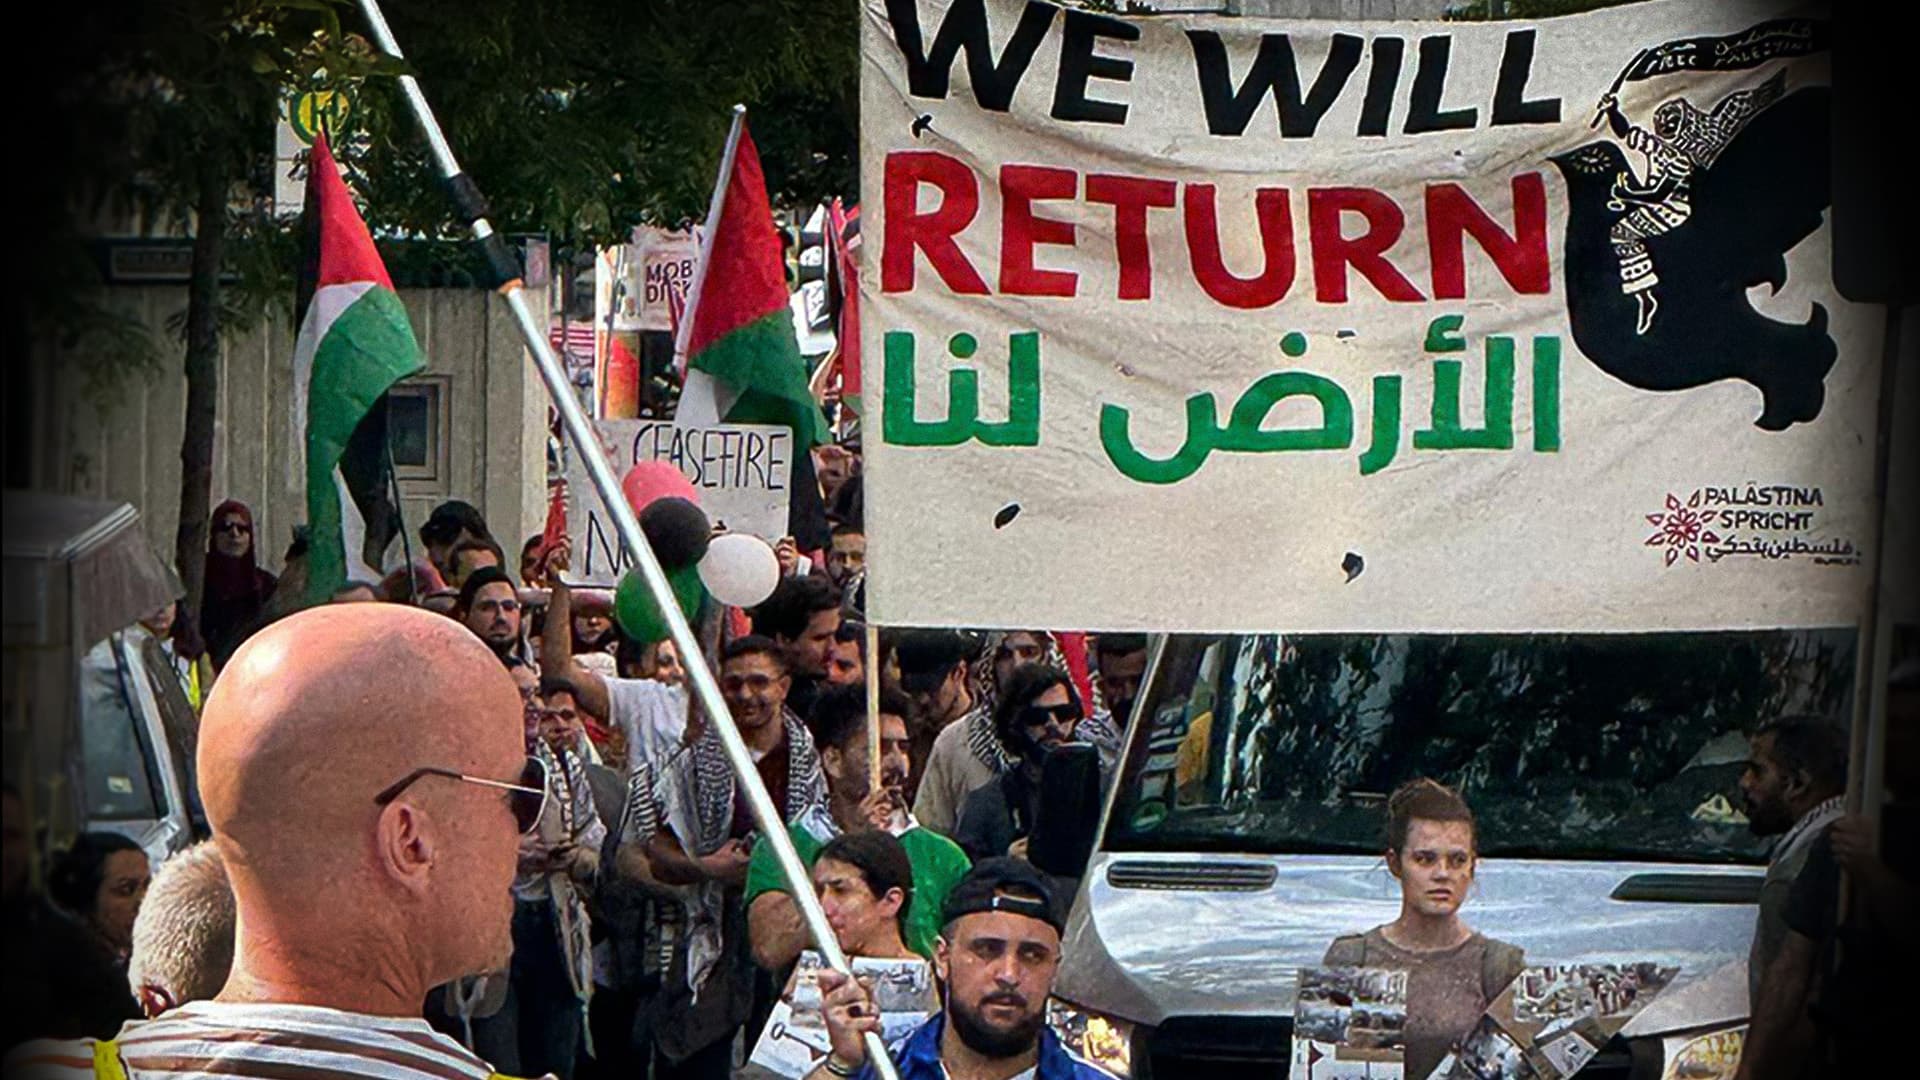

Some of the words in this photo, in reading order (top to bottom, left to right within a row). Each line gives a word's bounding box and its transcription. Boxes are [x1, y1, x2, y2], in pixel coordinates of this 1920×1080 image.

[887, 0, 1141, 125] WE
[1185, 29, 1562, 138] WILL
[646, 257, 698, 283] MOB
[879, 151, 1551, 309] RETURN
[882, 331, 1040, 447] لنا
[1101, 314, 1561, 484] الأرض
[1704, 481, 1824, 506] PALÄSTINA
[1720, 510, 1814, 530] SPRICHT
